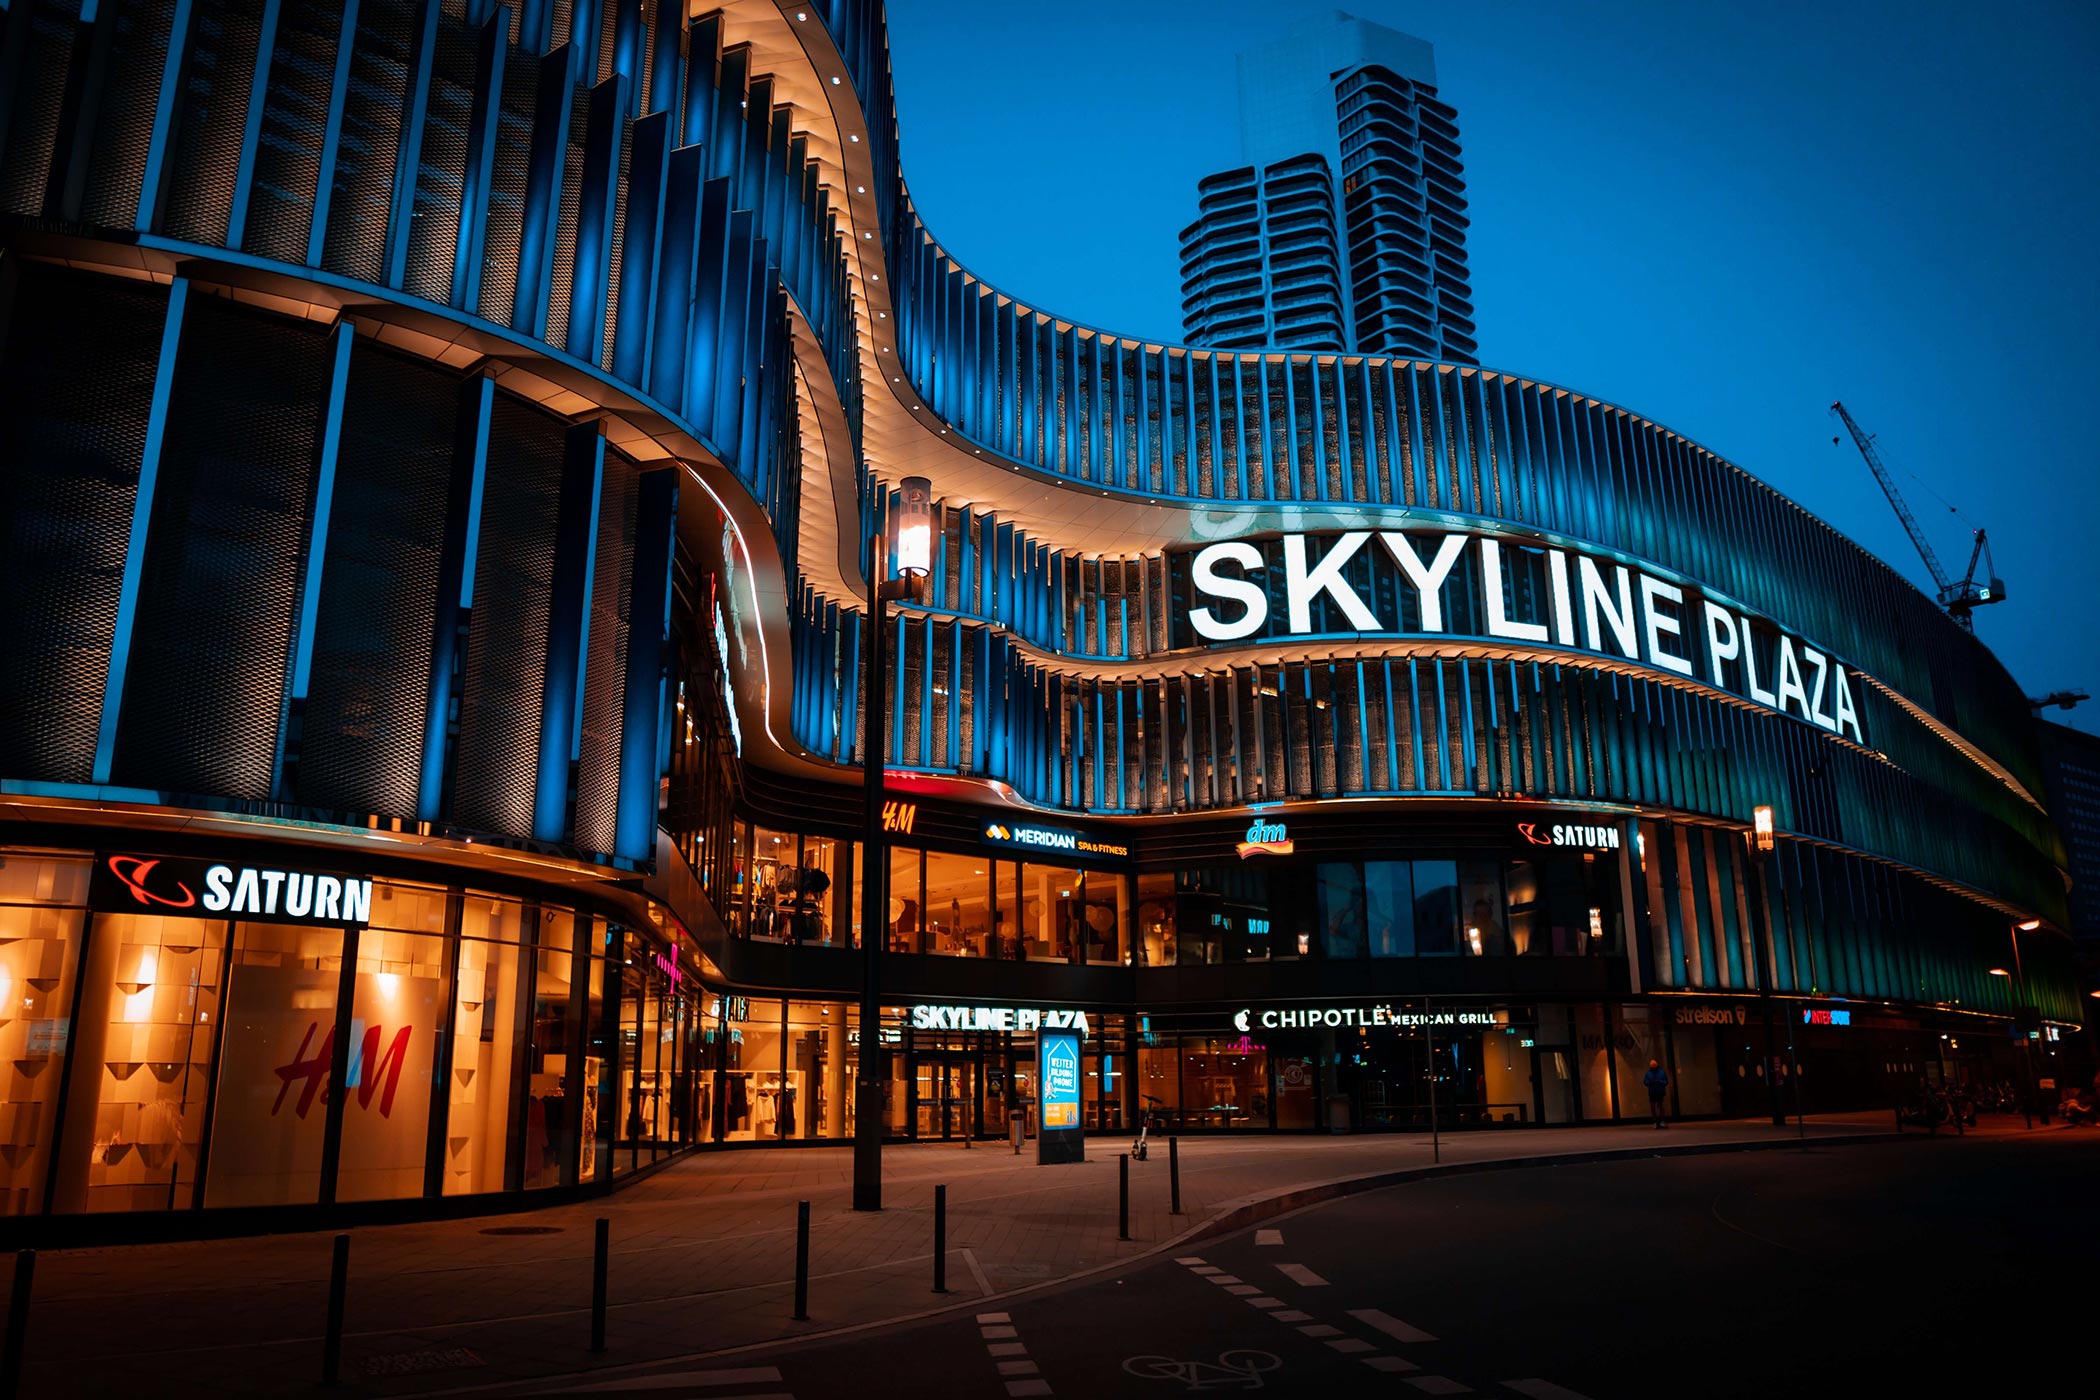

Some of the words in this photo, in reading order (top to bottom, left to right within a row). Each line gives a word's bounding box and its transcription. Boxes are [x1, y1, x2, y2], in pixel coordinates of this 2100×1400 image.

[1189, 530, 1692, 677] SKYLINE
[1704, 600, 1863, 743] PLAZA
[881, 802, 916, 835] H&M
[1246, 818, 1287, 844] dm
[1014, 827, 1075, 850] MERIDIAN
[1078, 841, 1092, 851] SPA
[1092, 844, 1098, 852] &
[1099, 845, 1128, 856] FITNESS
[1553, 825, 1620, 849] SATURN
[203, 865, 372, 922] SATURN
[912, 1005, 1014, 1031] SKYLINE
[1018, 1009, 1090, 1033] PLAZA
[1262, 1008, 1387, 1029] CHIPOTLE
[1391, 1014, 1454, 1025] MEXICAN
[1459, 1013, 1497, 1024] GRILL
[1676, 1005, 1733, 1024] strellson
[1051, 1058, 1074, 1069] WEITER
